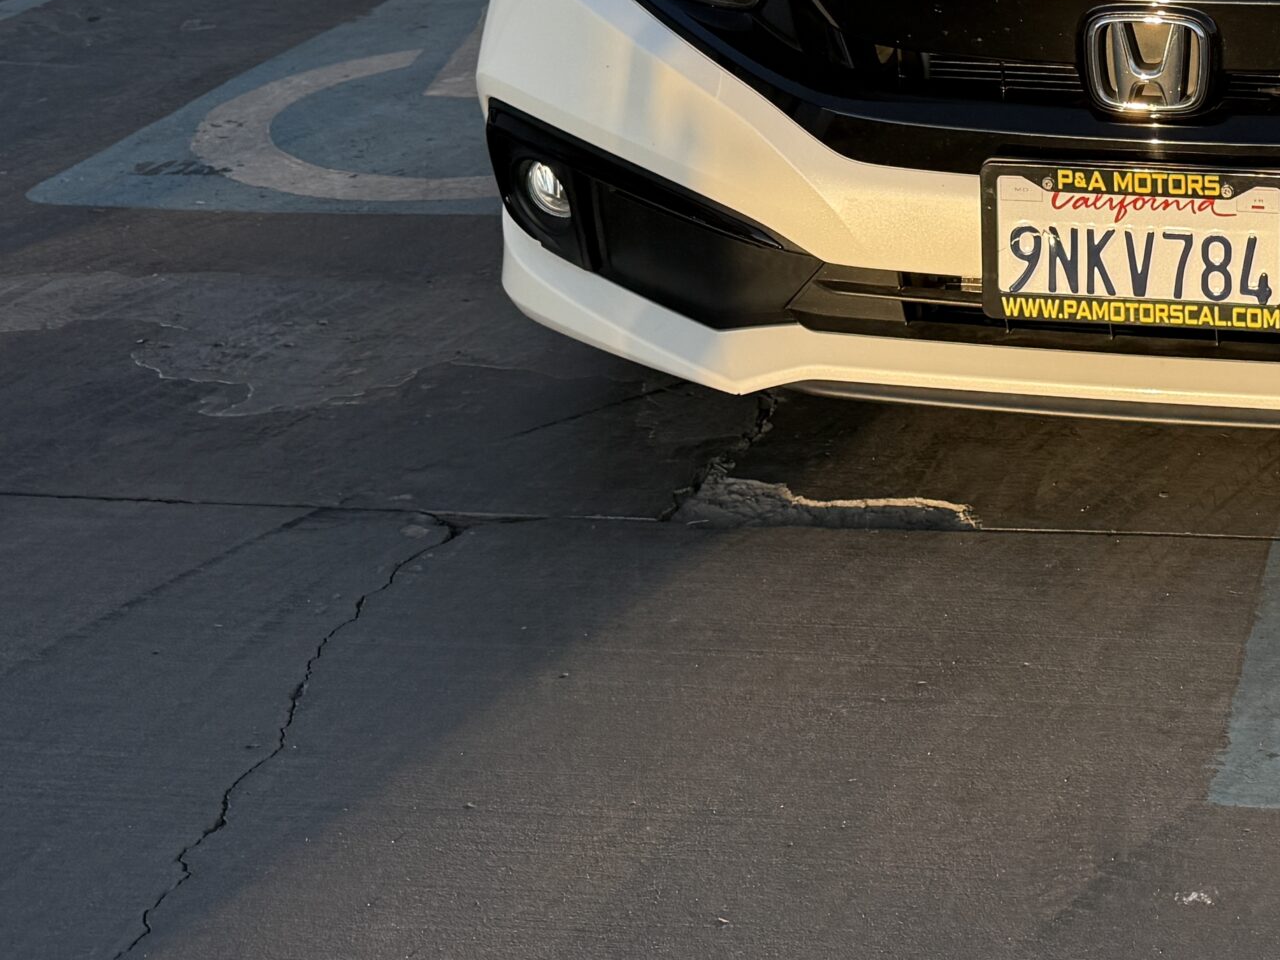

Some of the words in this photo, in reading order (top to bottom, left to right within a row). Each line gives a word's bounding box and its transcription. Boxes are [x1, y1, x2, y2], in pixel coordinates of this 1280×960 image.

[1057, 169, 1106, 190] P&A
[1113, 172, 1220, 196] MOTORS
[1051, 192, 1237, 223] California
[1009, 226, 1272, 305] 9NKV784
[1001, 297, 1280, 329] WWW.PAMOTORSCAL.COM
